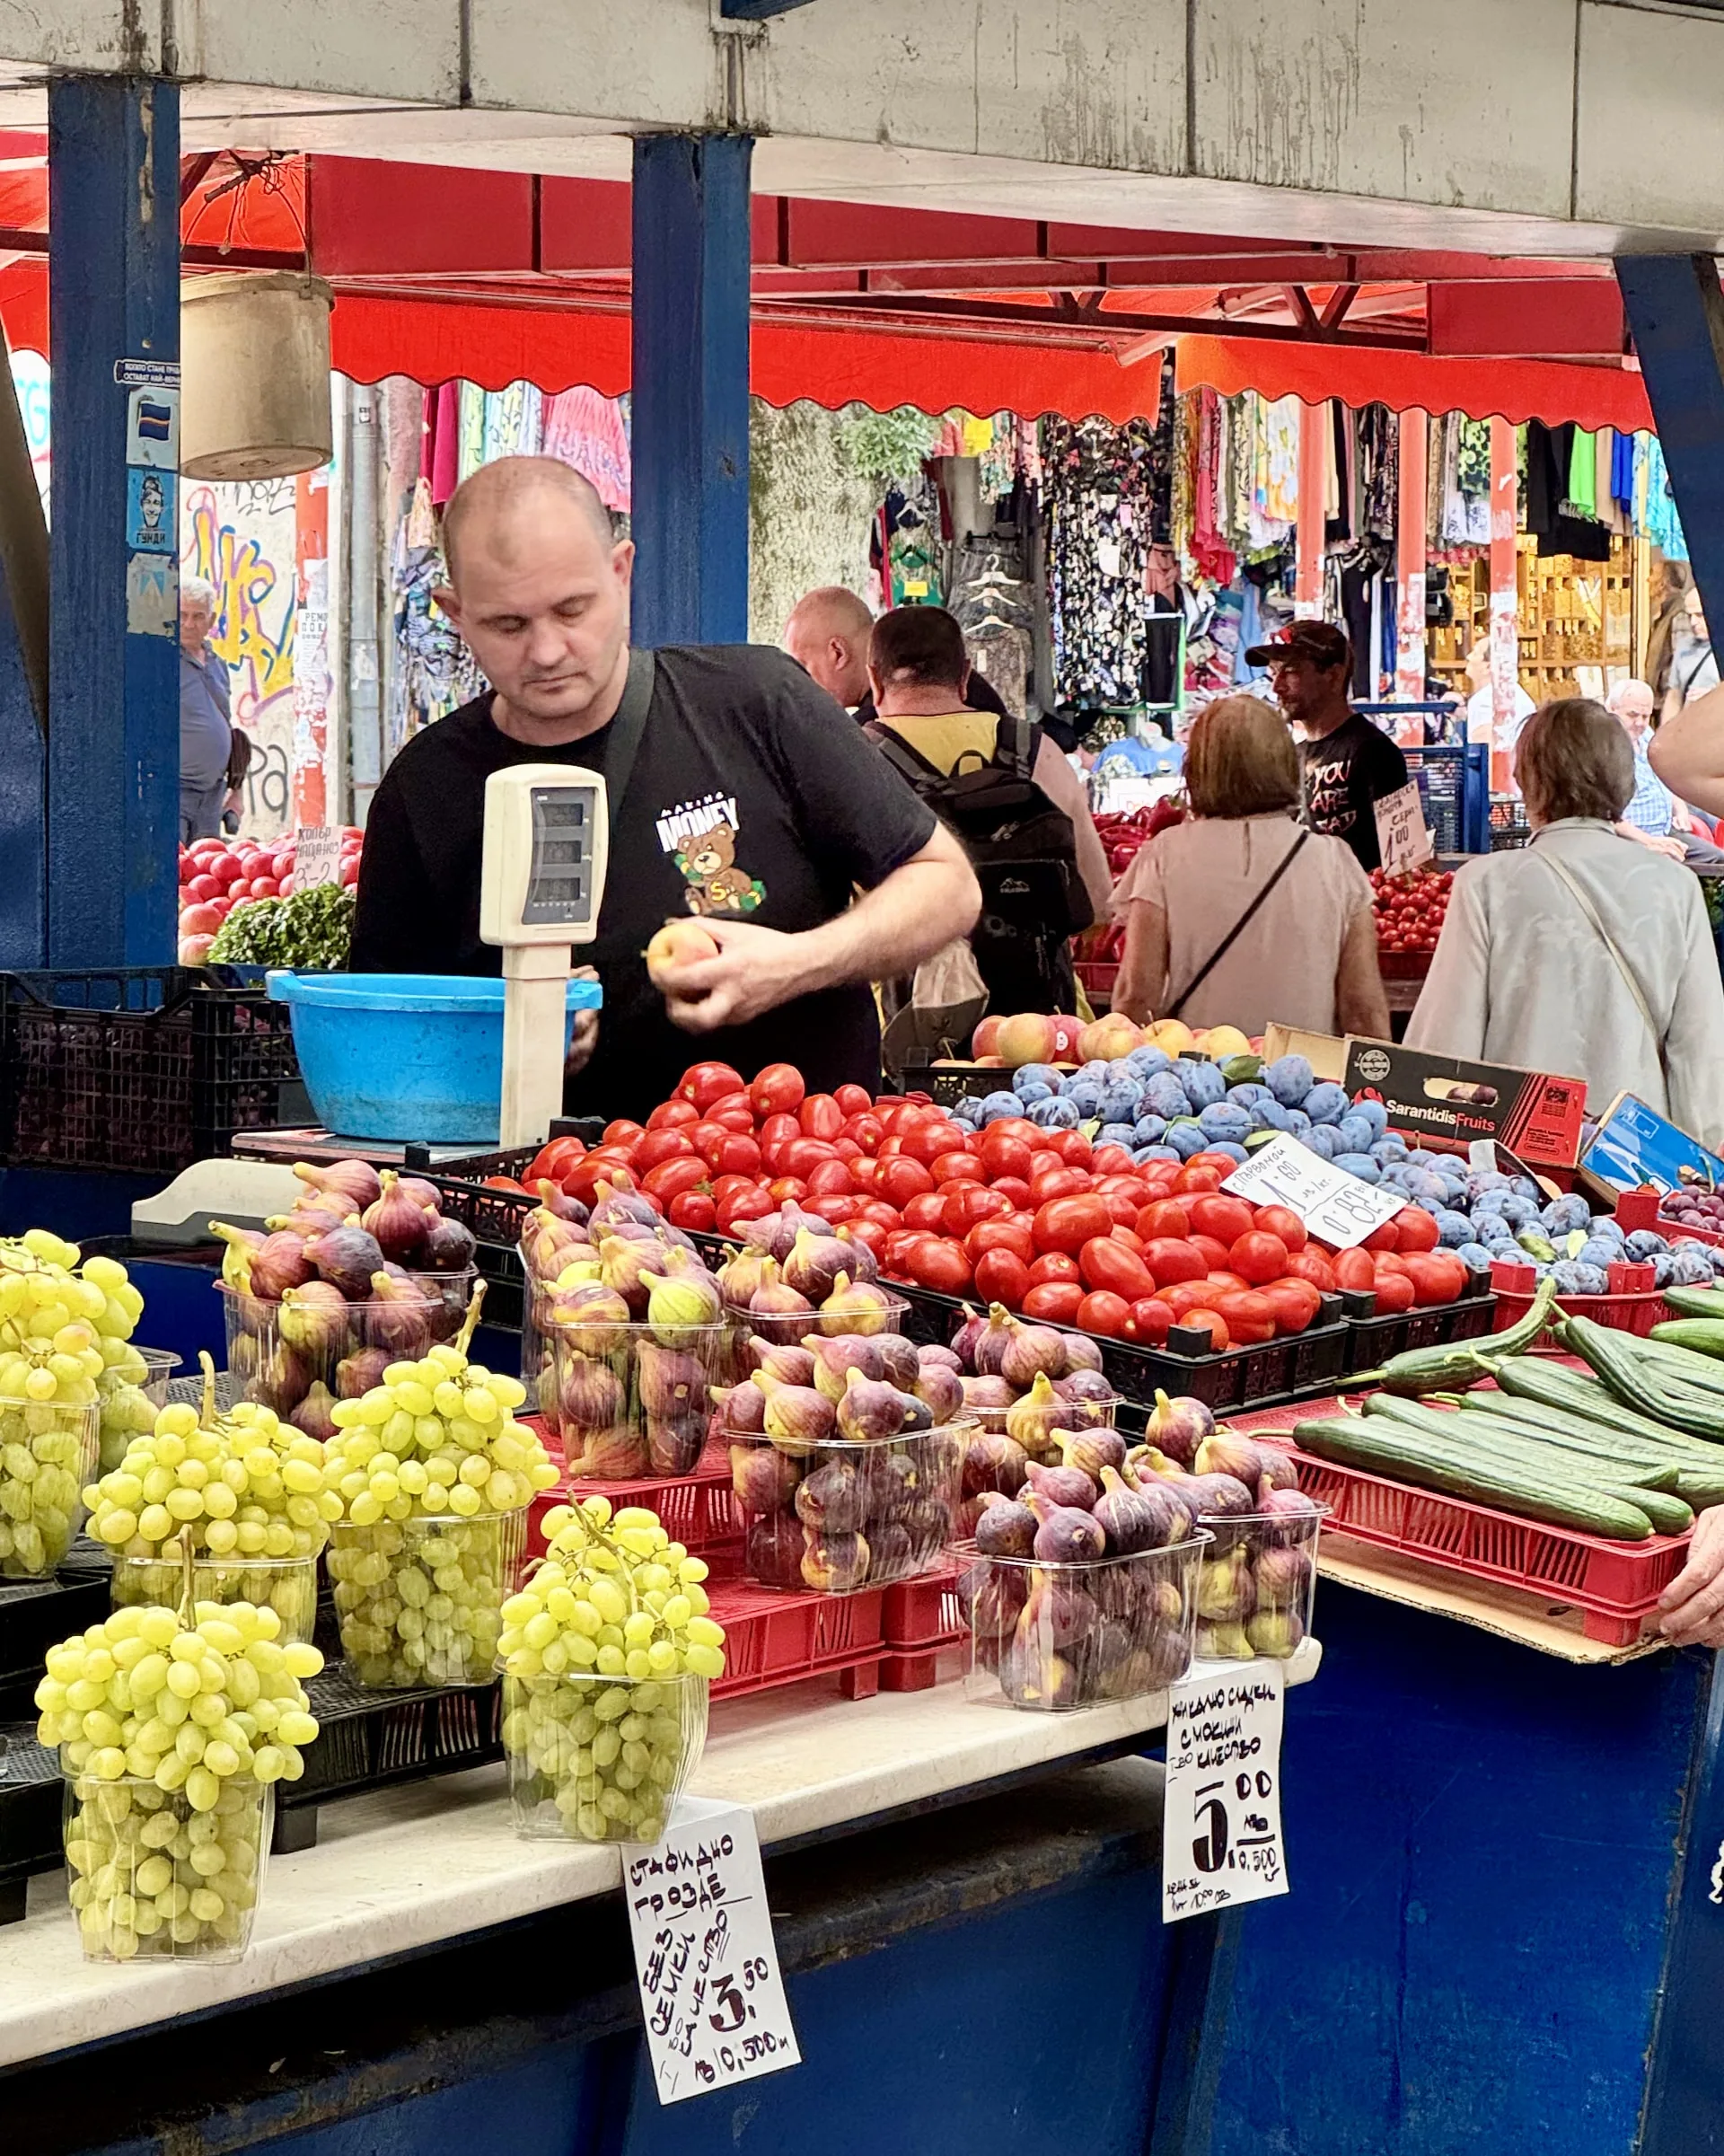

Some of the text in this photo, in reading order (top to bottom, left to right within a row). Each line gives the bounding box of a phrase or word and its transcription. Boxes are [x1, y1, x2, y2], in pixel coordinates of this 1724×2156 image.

[136, 532, 166, 544] ГУНДИ
[655, 797, 740, 853] MONEY
[630, 1834, 734, 1887] СТАФИДНО
[634, 1872, 726, 1922] ГРОЗДЕ
[642, 1928, 673, 1994] БЕЗ
[649, 1932, 696, 2037] СЕМКИ
